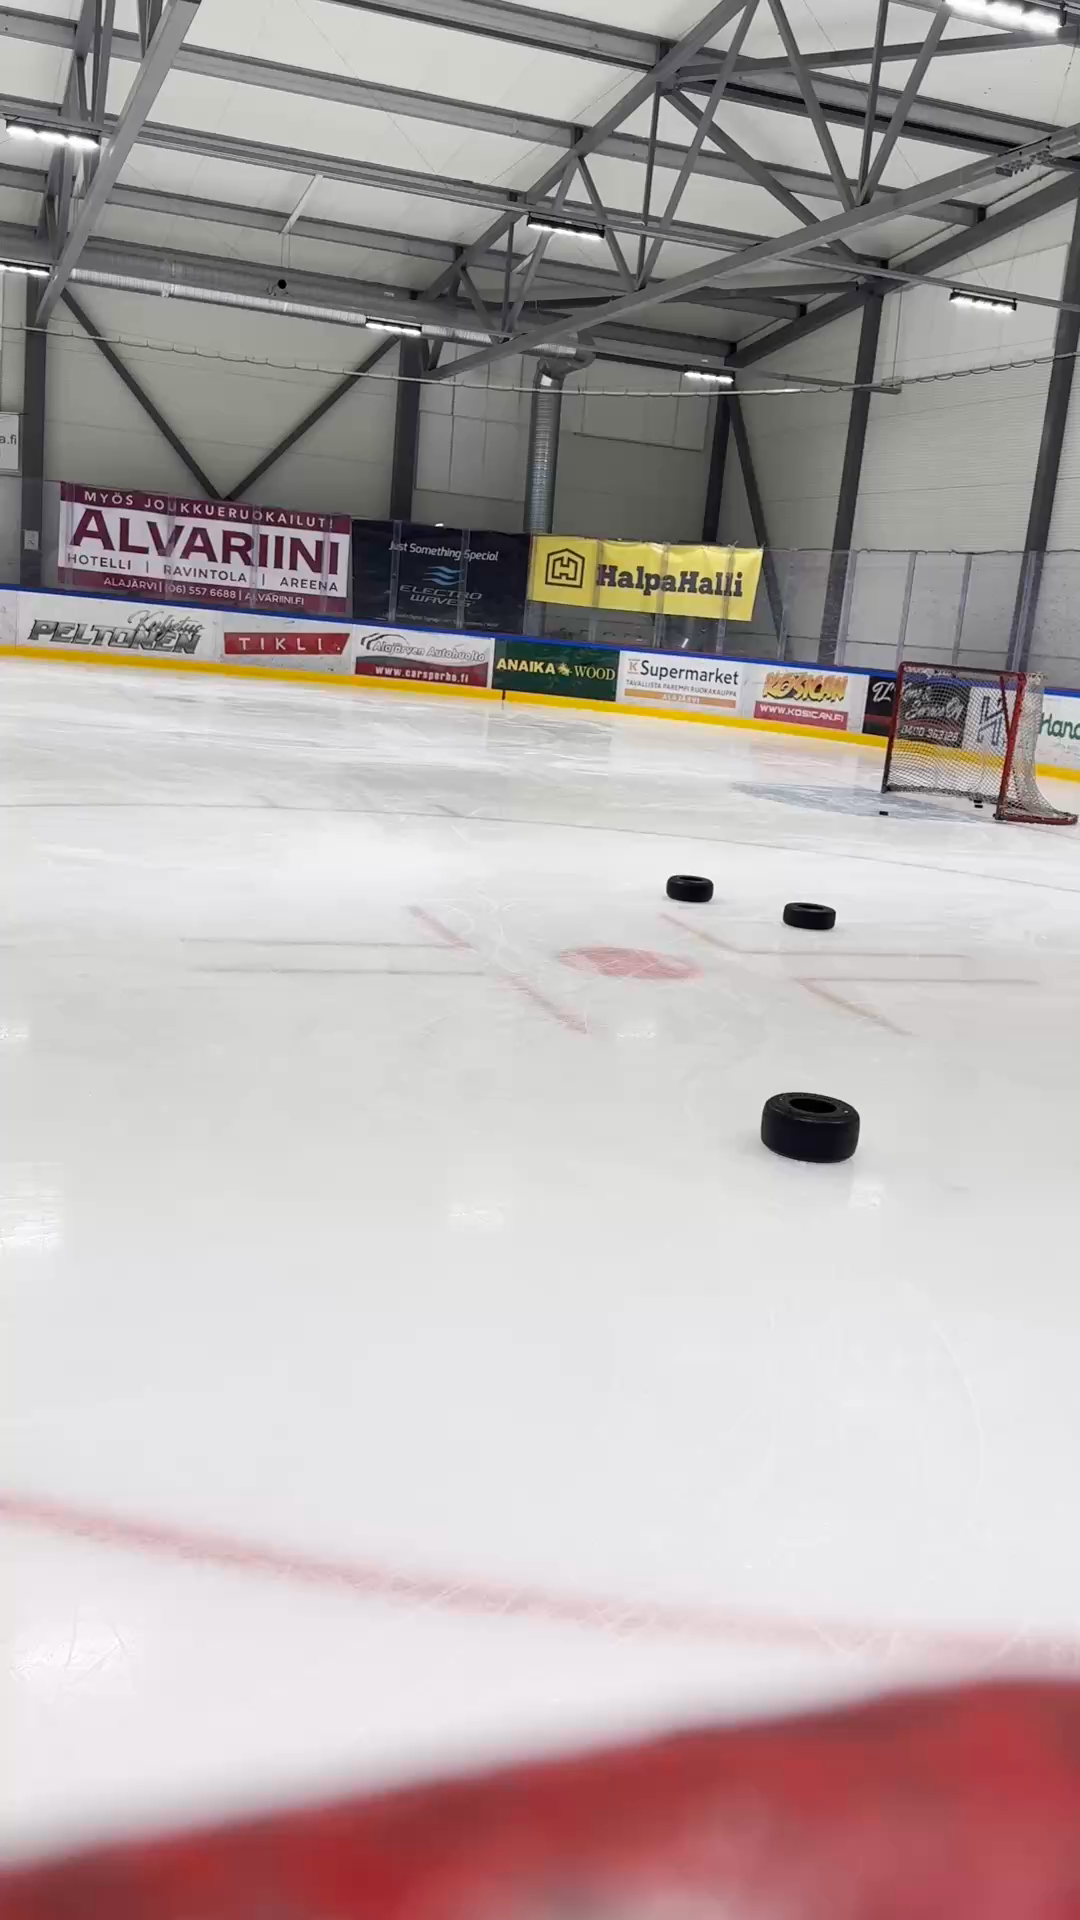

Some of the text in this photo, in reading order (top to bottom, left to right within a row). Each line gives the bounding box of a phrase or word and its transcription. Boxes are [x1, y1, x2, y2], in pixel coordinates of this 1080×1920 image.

[84, 491, 134, 506] MYÖS
[69, 508, 340, 575] ALVARIINI
[388, 541, 499, 562] Just Something Special
[67, 553, 338, 592] HOTELLI RAVINTOLA AREENA
[597, 564, 743, 597] HalpaHalli
[165, 584, 186, 595] (06)
[189, 586, 207, 596] 557
[209, 589, 236, 599] 6688
[245, 592, 304, 605] AVARIINI.FI
[27, 619, 201, 654] PELTONEN
[373, 641, 486, 661] Alajärven Autohuolto
[496, 657, 616, 681] ANAIKA WOOD
[640, 659, 739, 686] Supermarket
